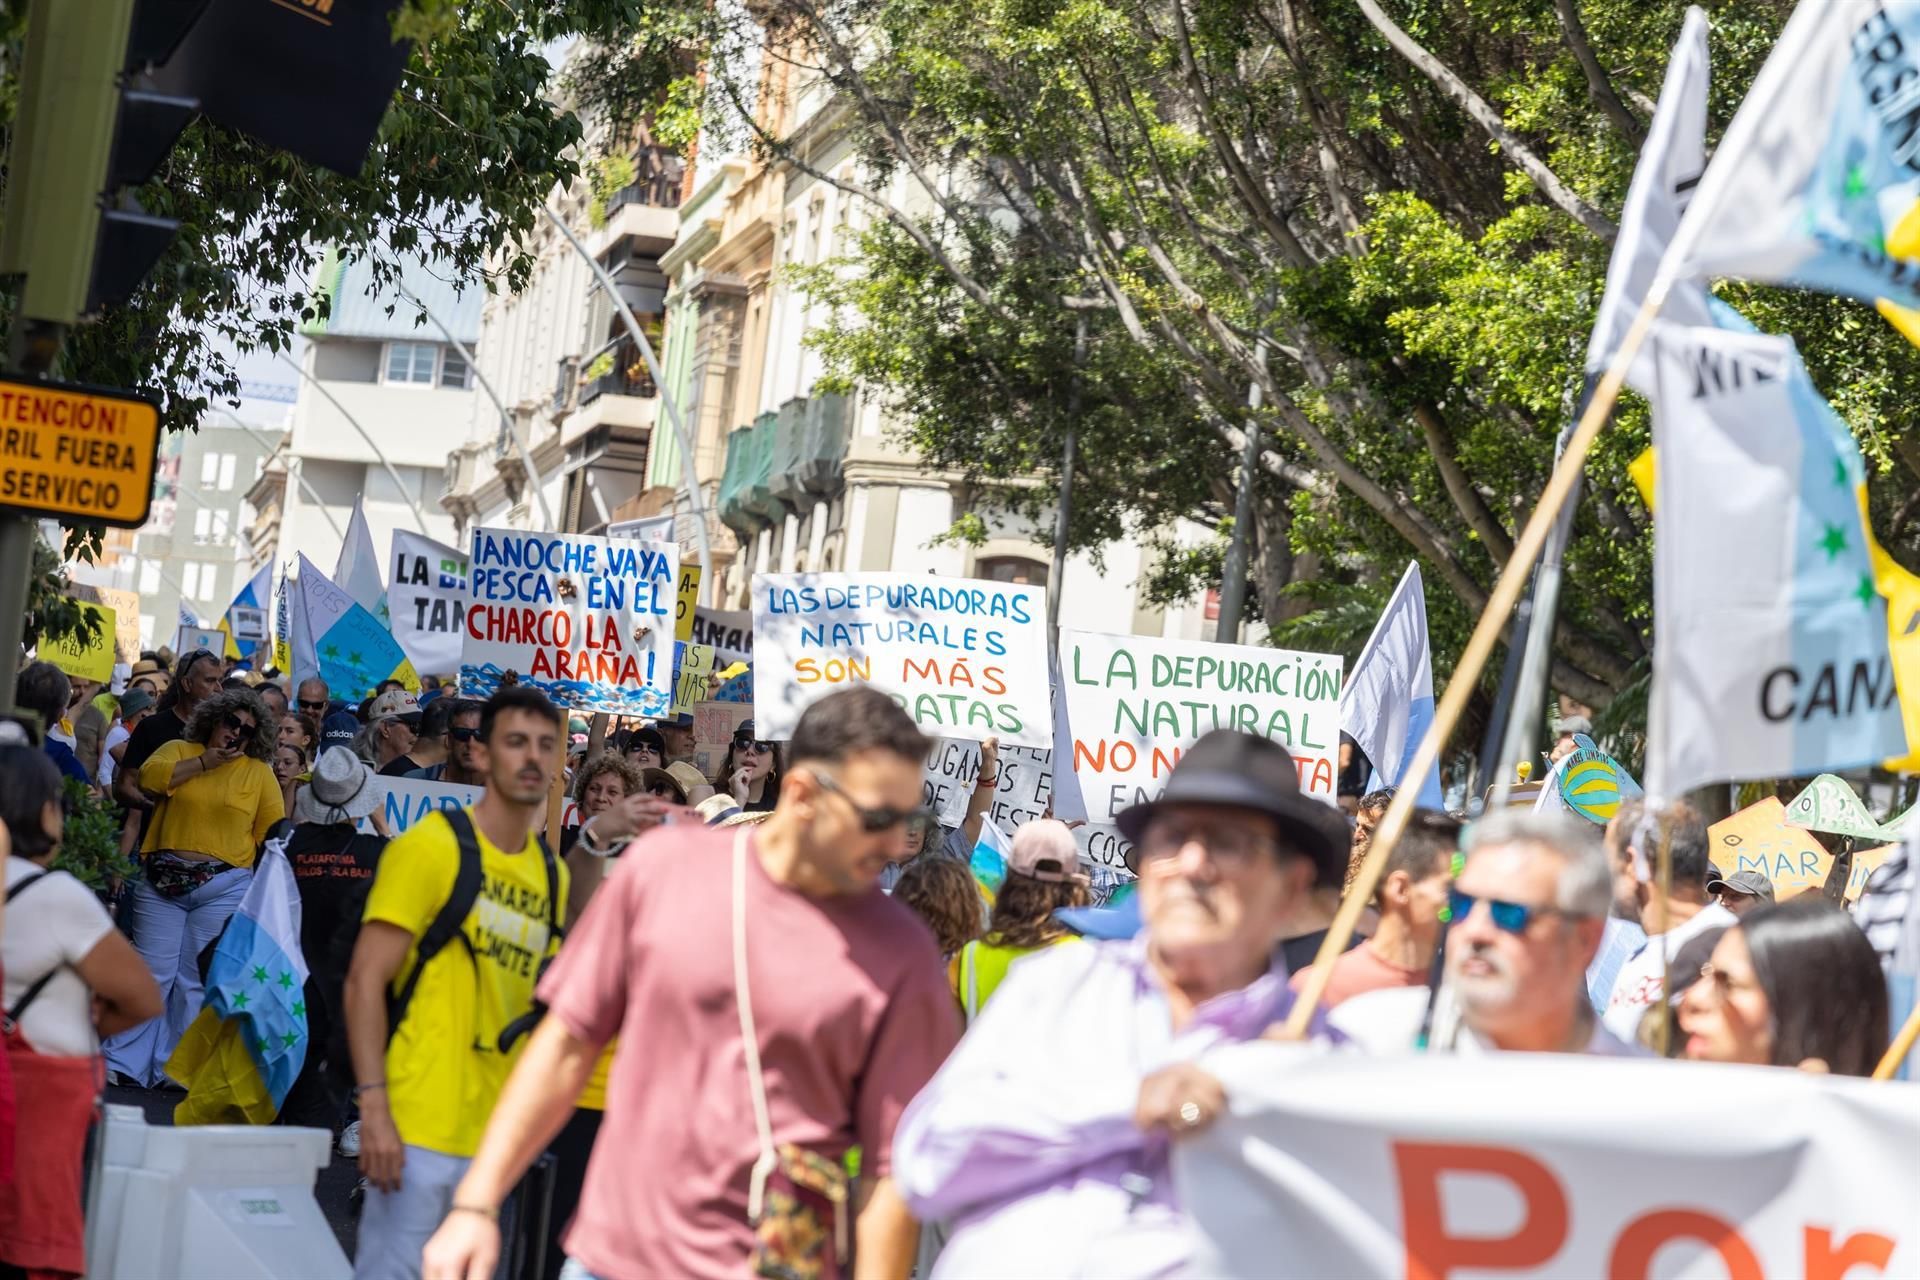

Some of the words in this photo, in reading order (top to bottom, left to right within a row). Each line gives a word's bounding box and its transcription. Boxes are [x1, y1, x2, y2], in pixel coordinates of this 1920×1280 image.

[1, 393, 128, 435] TENCIÓN!
[0, 428, 42, 459] RIL
[56, 436, 136, 475] FUERA
[3, 468, 121, 510] SERVICIO
[396, 553, 429, 586] LA
[606, 547, 671, 583] VAYA
[473, 569, 552, 604] PESCA
[588, 577, 624, 610] EN
[634, 581, 668, 615] EL
[769, 587, 820, 614] LAS
[825, 583, 1031, 625] DEPURADORAS
[467, 604, 571, 648] CHARCO
[586, 614, 622, 651] LA
[801, 620, 1006, 656] NATURALES
[531, 647, 656, 687] ARAÑA!
[795, 656, 871, 683] SON
[903, 657, 1007, 695] MÁS
[1074, 645, 1137, 690] LA
[326, 730, 355, 739] adidas
[1114, 698, 1325, 750] NATURAL
[1073, 738, 1137, 773] NO
[1738, 850, 1821, 880] MAR
